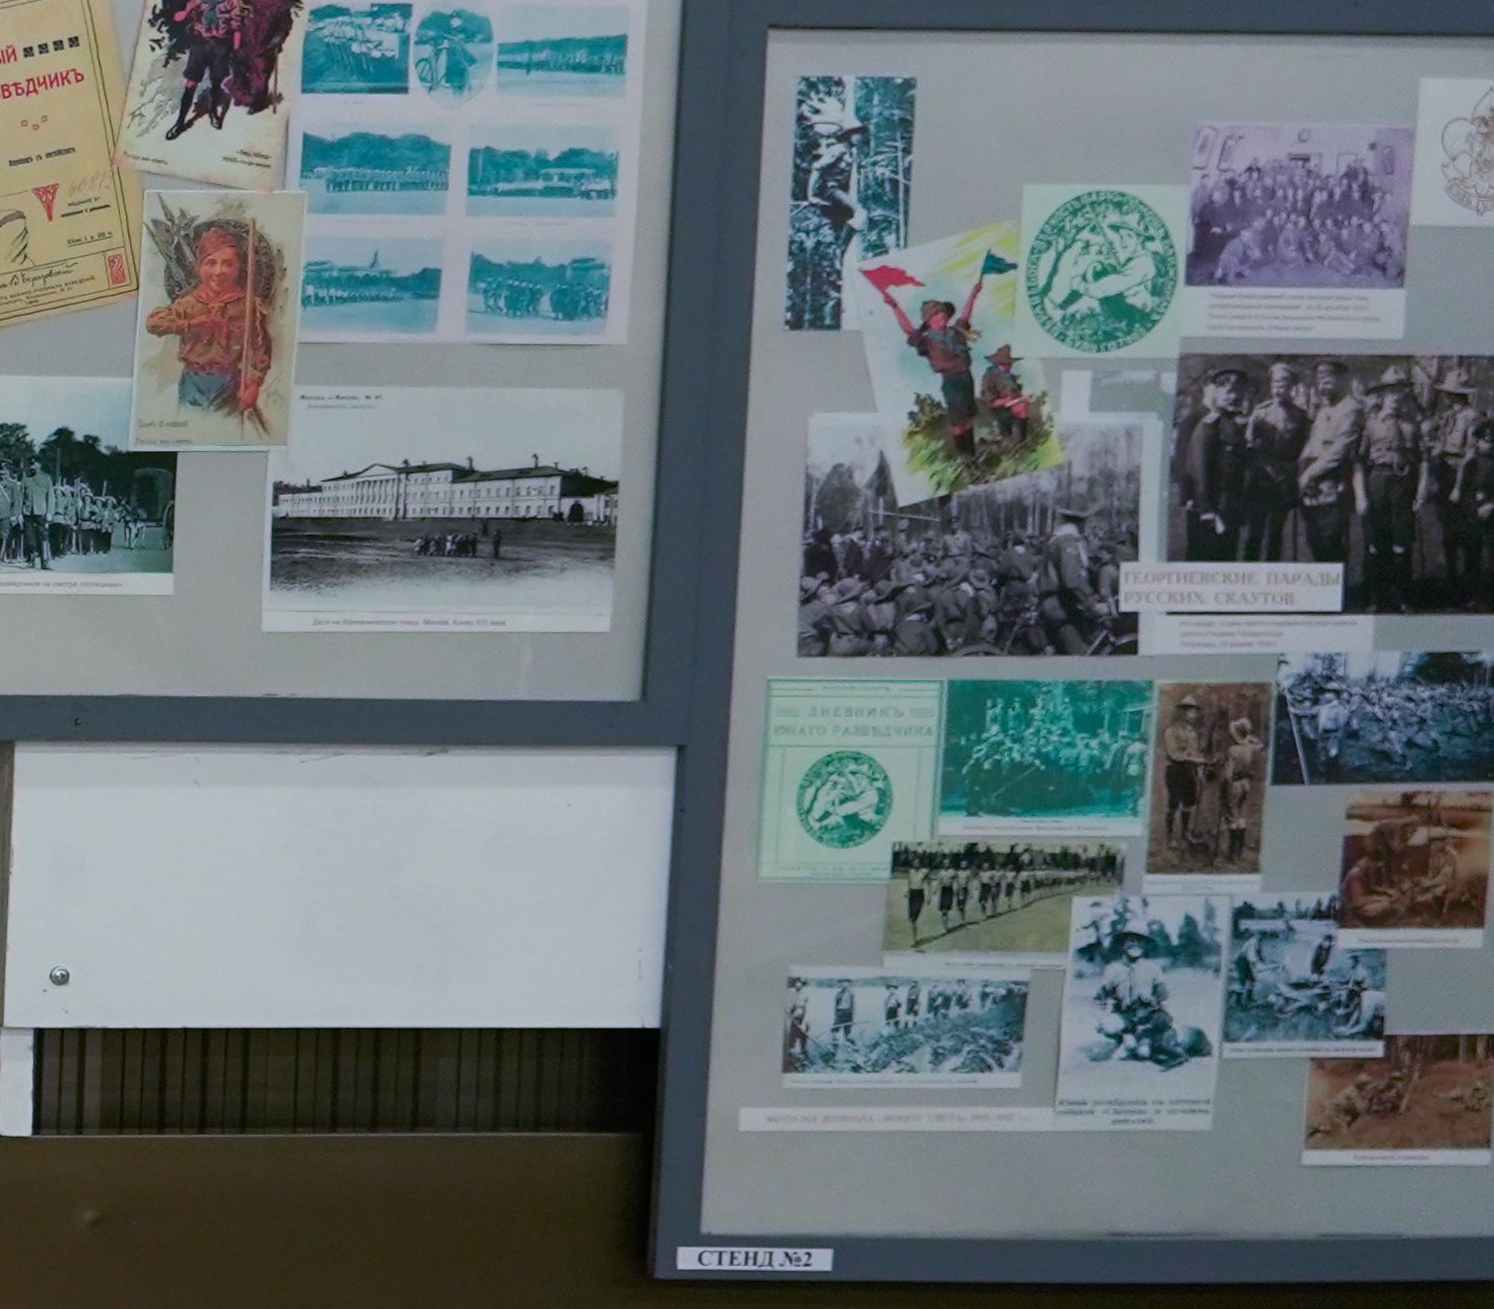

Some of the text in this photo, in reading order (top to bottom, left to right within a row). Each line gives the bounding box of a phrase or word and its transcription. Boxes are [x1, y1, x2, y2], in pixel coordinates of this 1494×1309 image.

[1124, 571, 1342, 588] ГЕОРГИЕВСКИЕ ПАРАДЫ
[1124, 590, 1294, 606] РУССКИХ СКАУТОВ
[697, 1251, 813, 1268] СТЕНД №2
